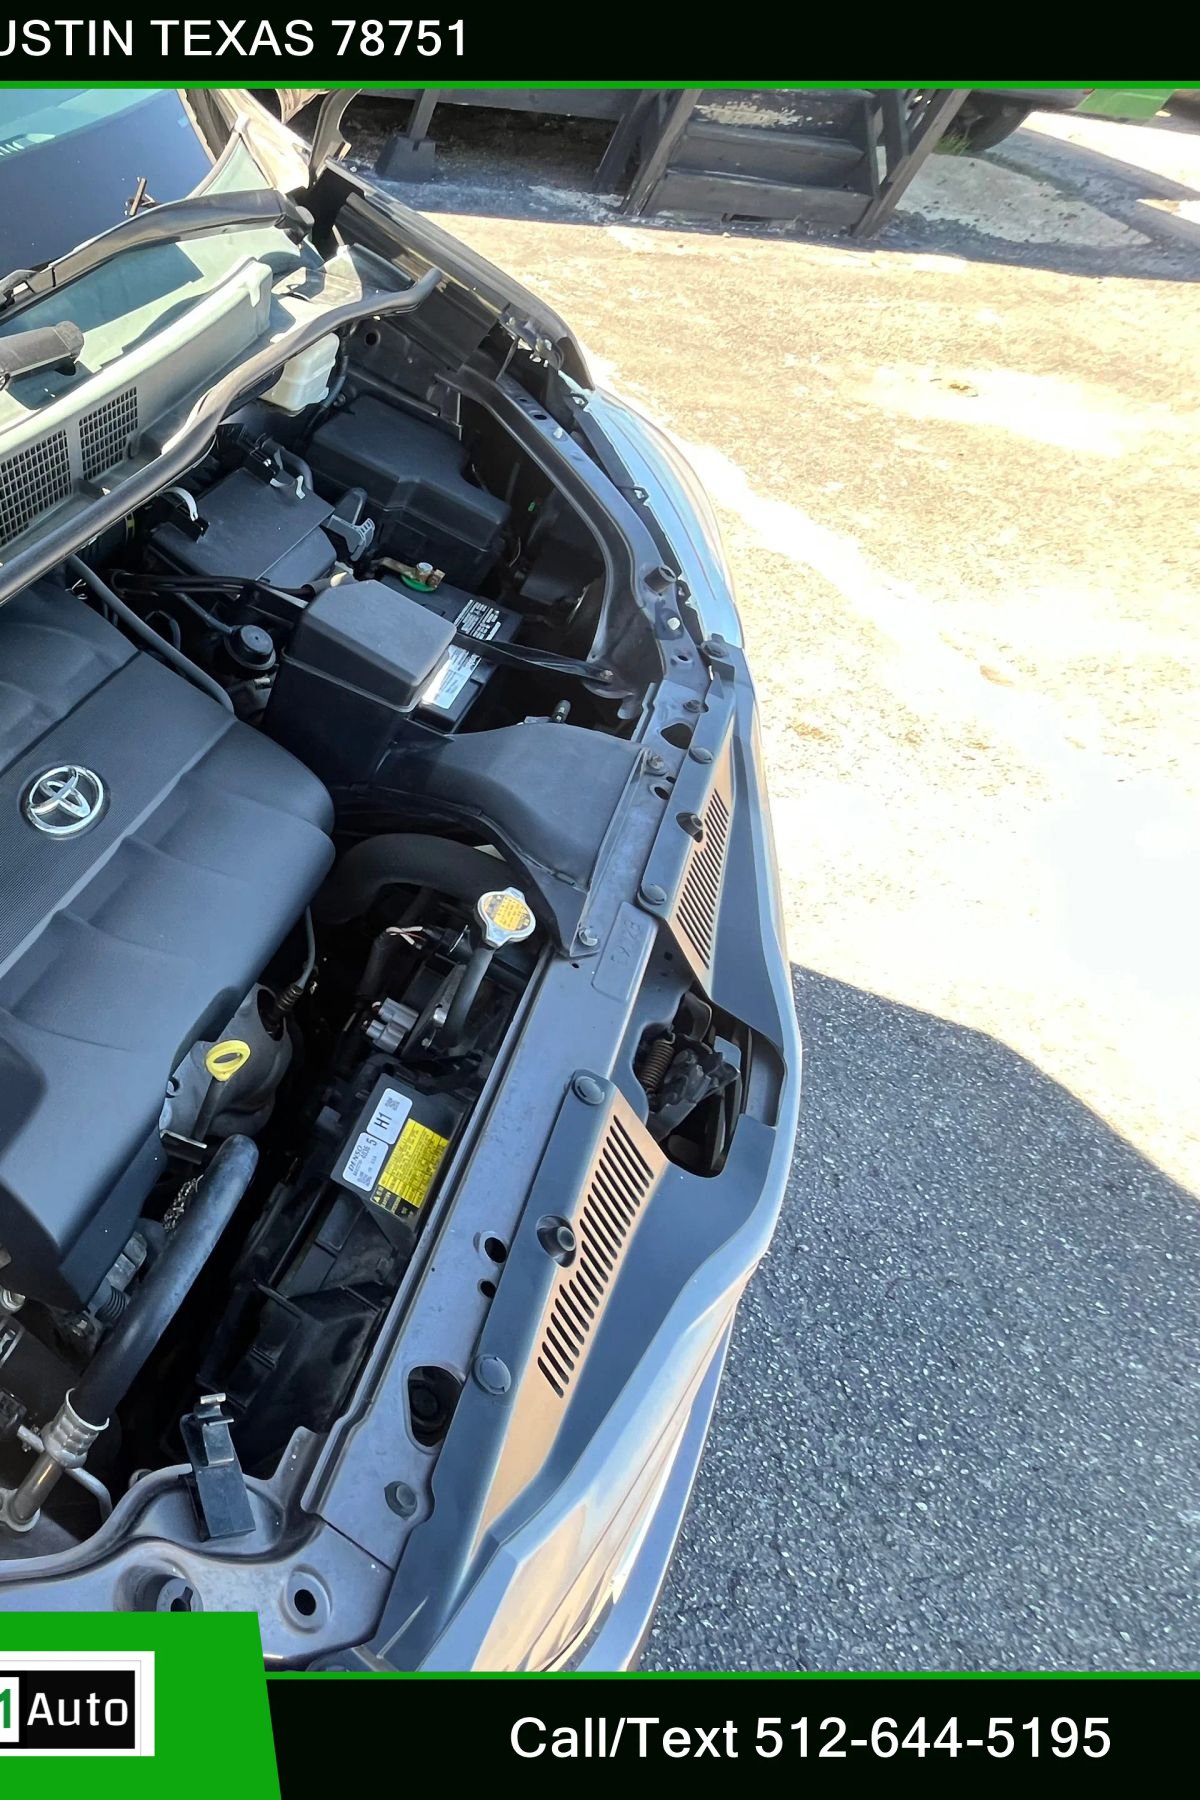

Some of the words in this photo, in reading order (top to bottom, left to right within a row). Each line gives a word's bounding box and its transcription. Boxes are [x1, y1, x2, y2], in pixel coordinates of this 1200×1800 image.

[373, 1111, 393, 1131] H1
[366, 1137, 378, 1146] 5
[348, 1144, 363, 1172] DENSO
